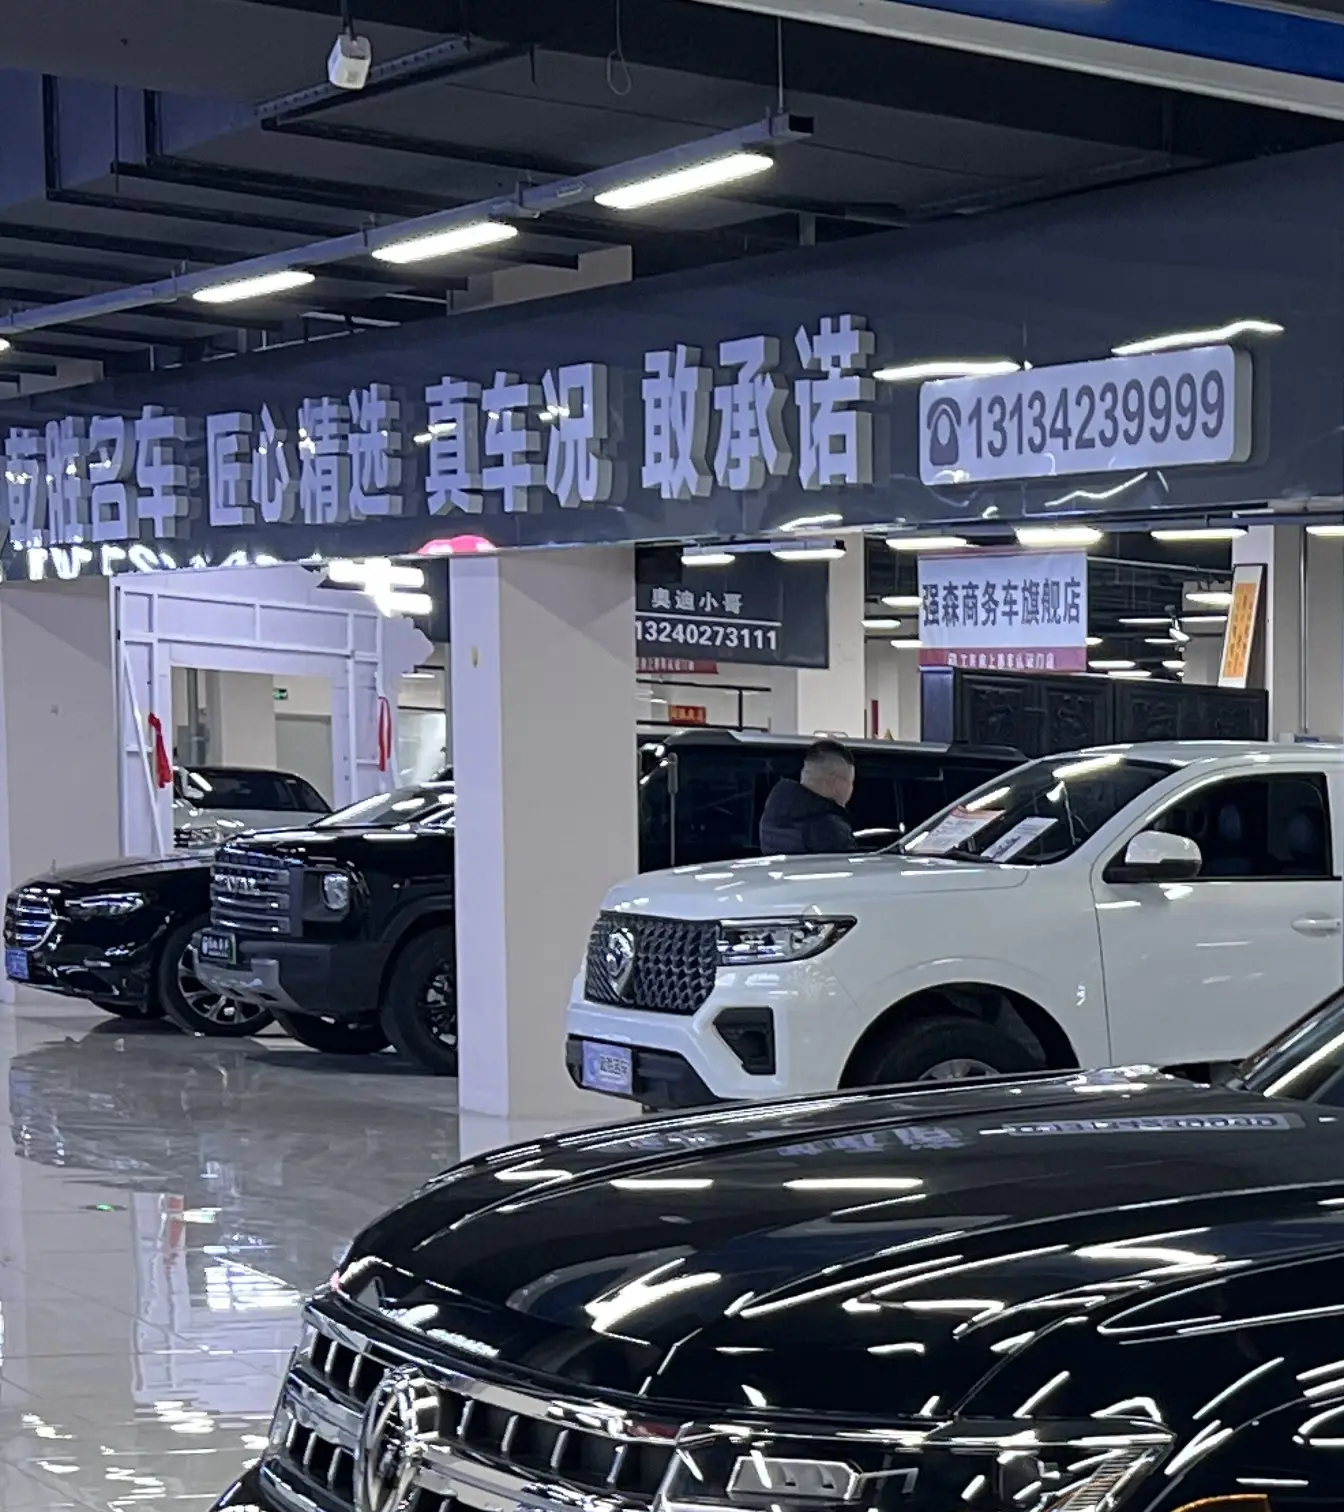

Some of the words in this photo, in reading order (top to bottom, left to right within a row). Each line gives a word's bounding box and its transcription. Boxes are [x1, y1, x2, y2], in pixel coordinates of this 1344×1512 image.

[208, 381, 402, 526] 匠心精选
[424, 362, 608, 514] 真车况
[641, 312, 874, 499] 敢承诺
[968, 370, 1225, 459] 13134239999
[652, 587, 743, 614] 奥迪小哥
[922, 576, 1081, 627] 强森商务车旗舰店
[635, 620, 777, 650] 13240273111
